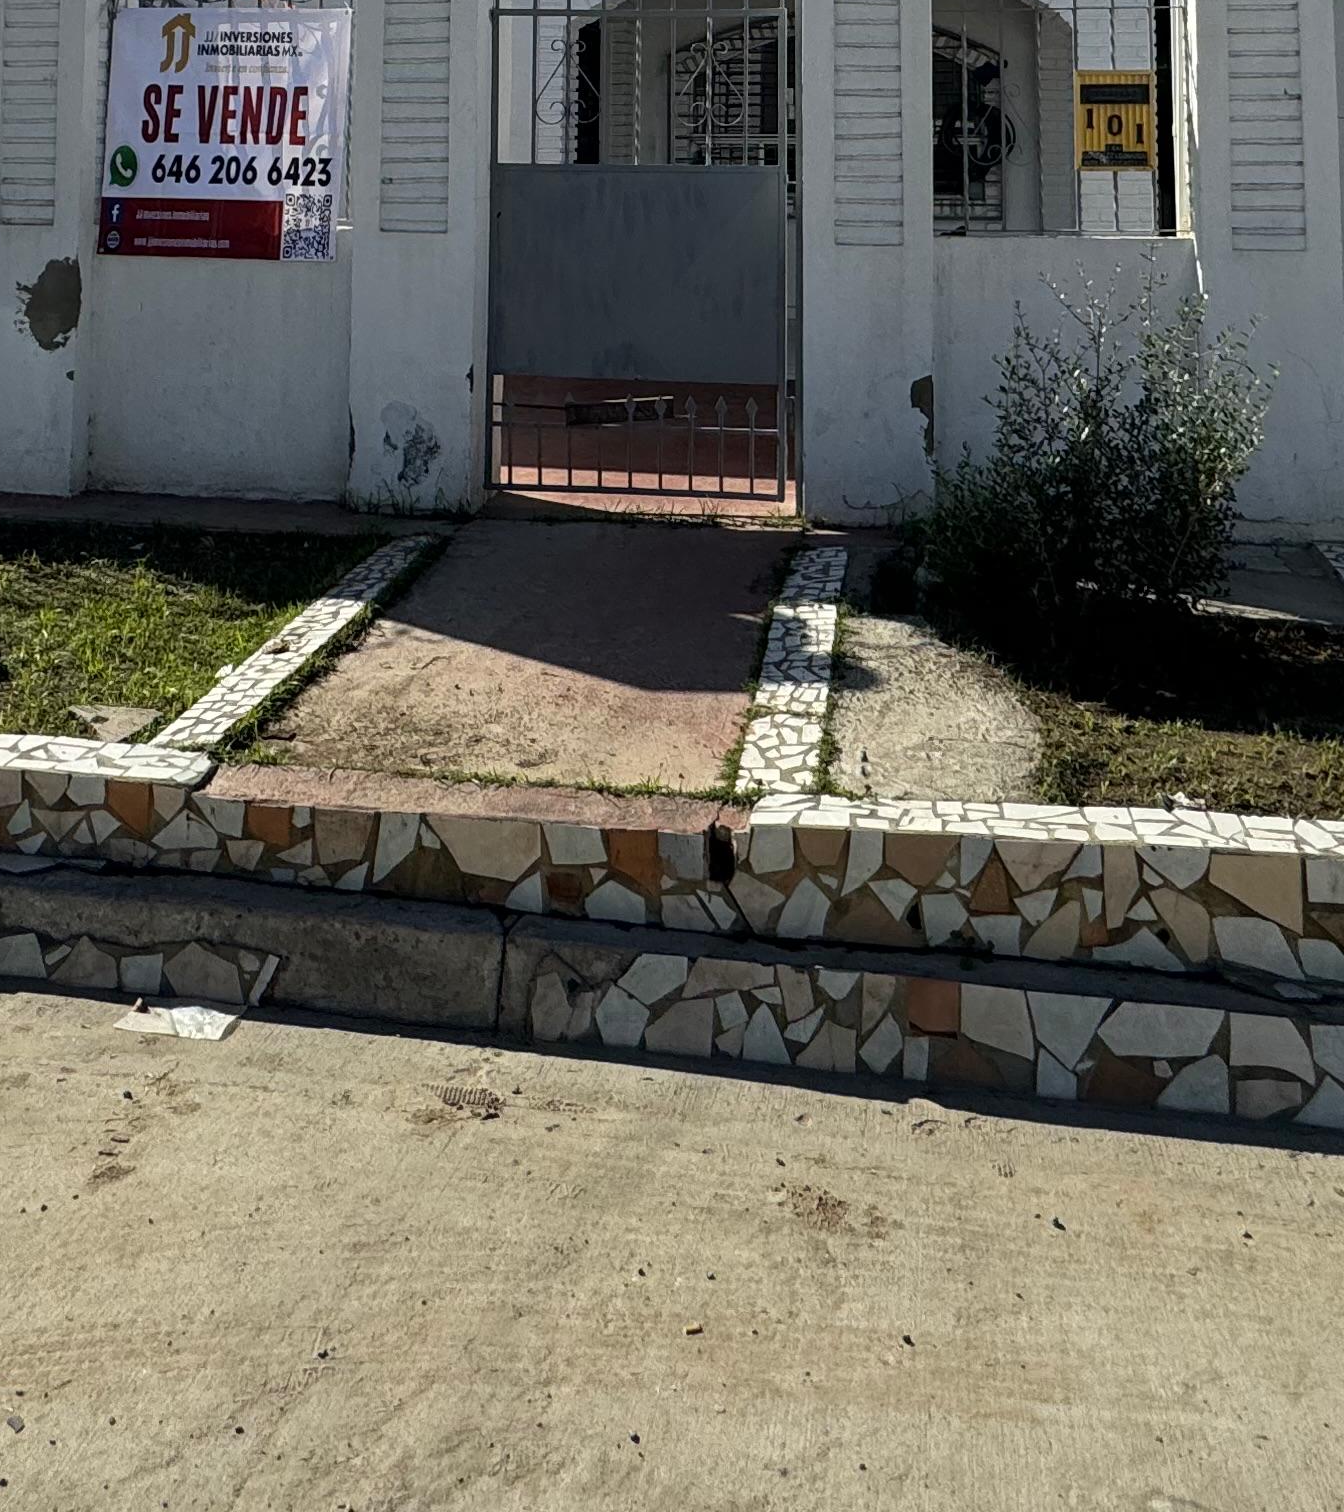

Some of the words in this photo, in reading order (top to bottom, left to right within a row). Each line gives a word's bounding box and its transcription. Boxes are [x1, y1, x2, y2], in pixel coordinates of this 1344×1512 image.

[220, 31, 293, 44] INVERSIONES
[197, 44, 281, 56] INMOBILIARIAS
[141, 83, 184, 144] SE
[197, 85, 309, 146] VENDE
[151, 154, 201, 184] 646
[208, 155, 257, 185] 206
[267, 157, 333, 187] 6423
